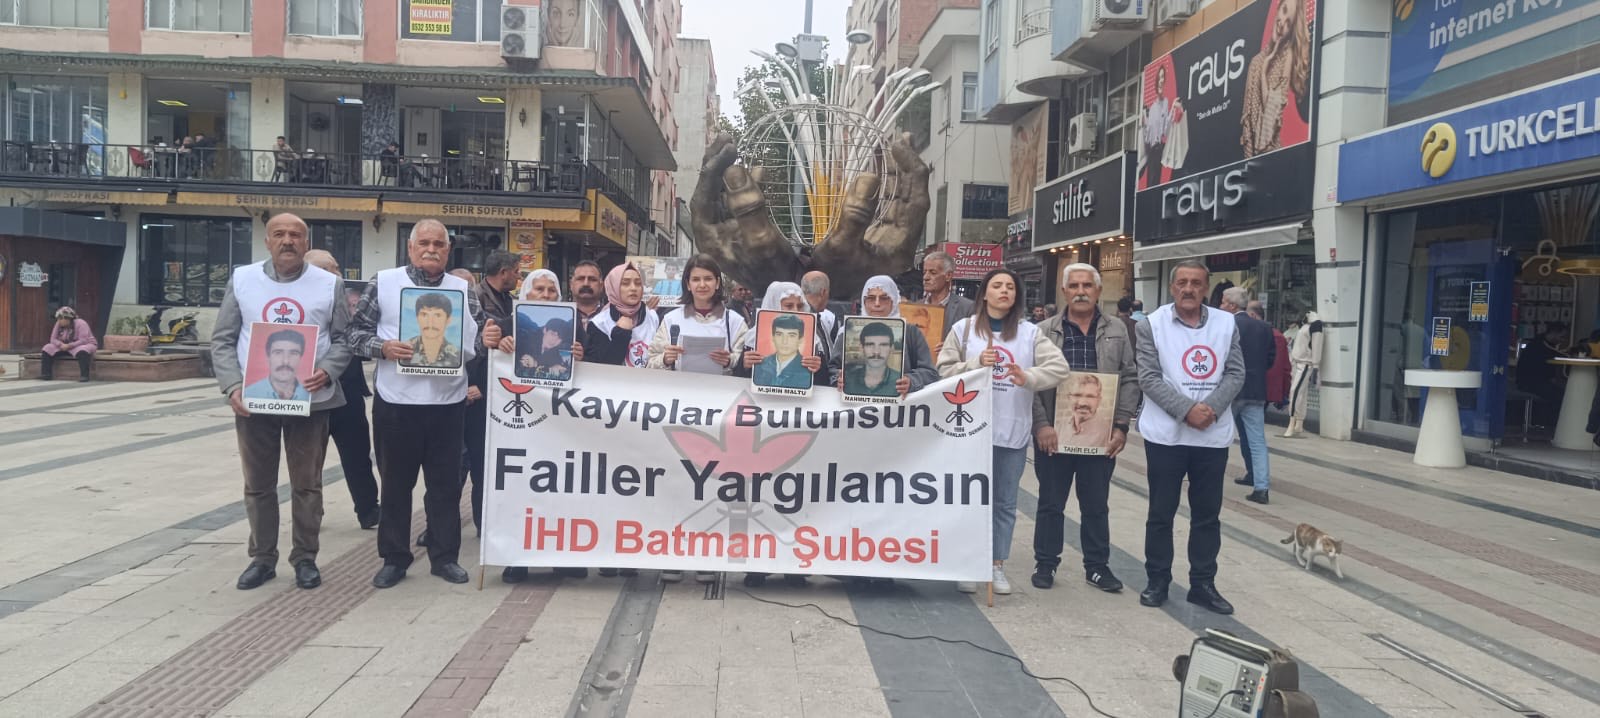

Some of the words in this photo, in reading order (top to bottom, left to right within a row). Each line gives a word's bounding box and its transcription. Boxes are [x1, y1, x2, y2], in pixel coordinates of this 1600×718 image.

[1429, 0, 1516, 49] internet
[1188, 39, 1245, 99] rays
[442, 205, 474, 215] ŞEHİR
[477, 206, 523, 216] SOFRASI
[1053, 179, 1093, 225] stilife
[1161, 169, 1243, 221] rays
[953, 258, 998, 267] ollection
[956, 246, 991, 258] Şirin
[552, 388, 722, 430] Kayıplar
[735, 403, 931, 429] Bulunsun
[494, 447, 666, 497] Failler
[680, 459, 990, 514] Yargılansın
[523, 508, 599, 553] İHD
[615, 520, 777, 560] Batman
[793, 526, 940, 569] Şubesi
